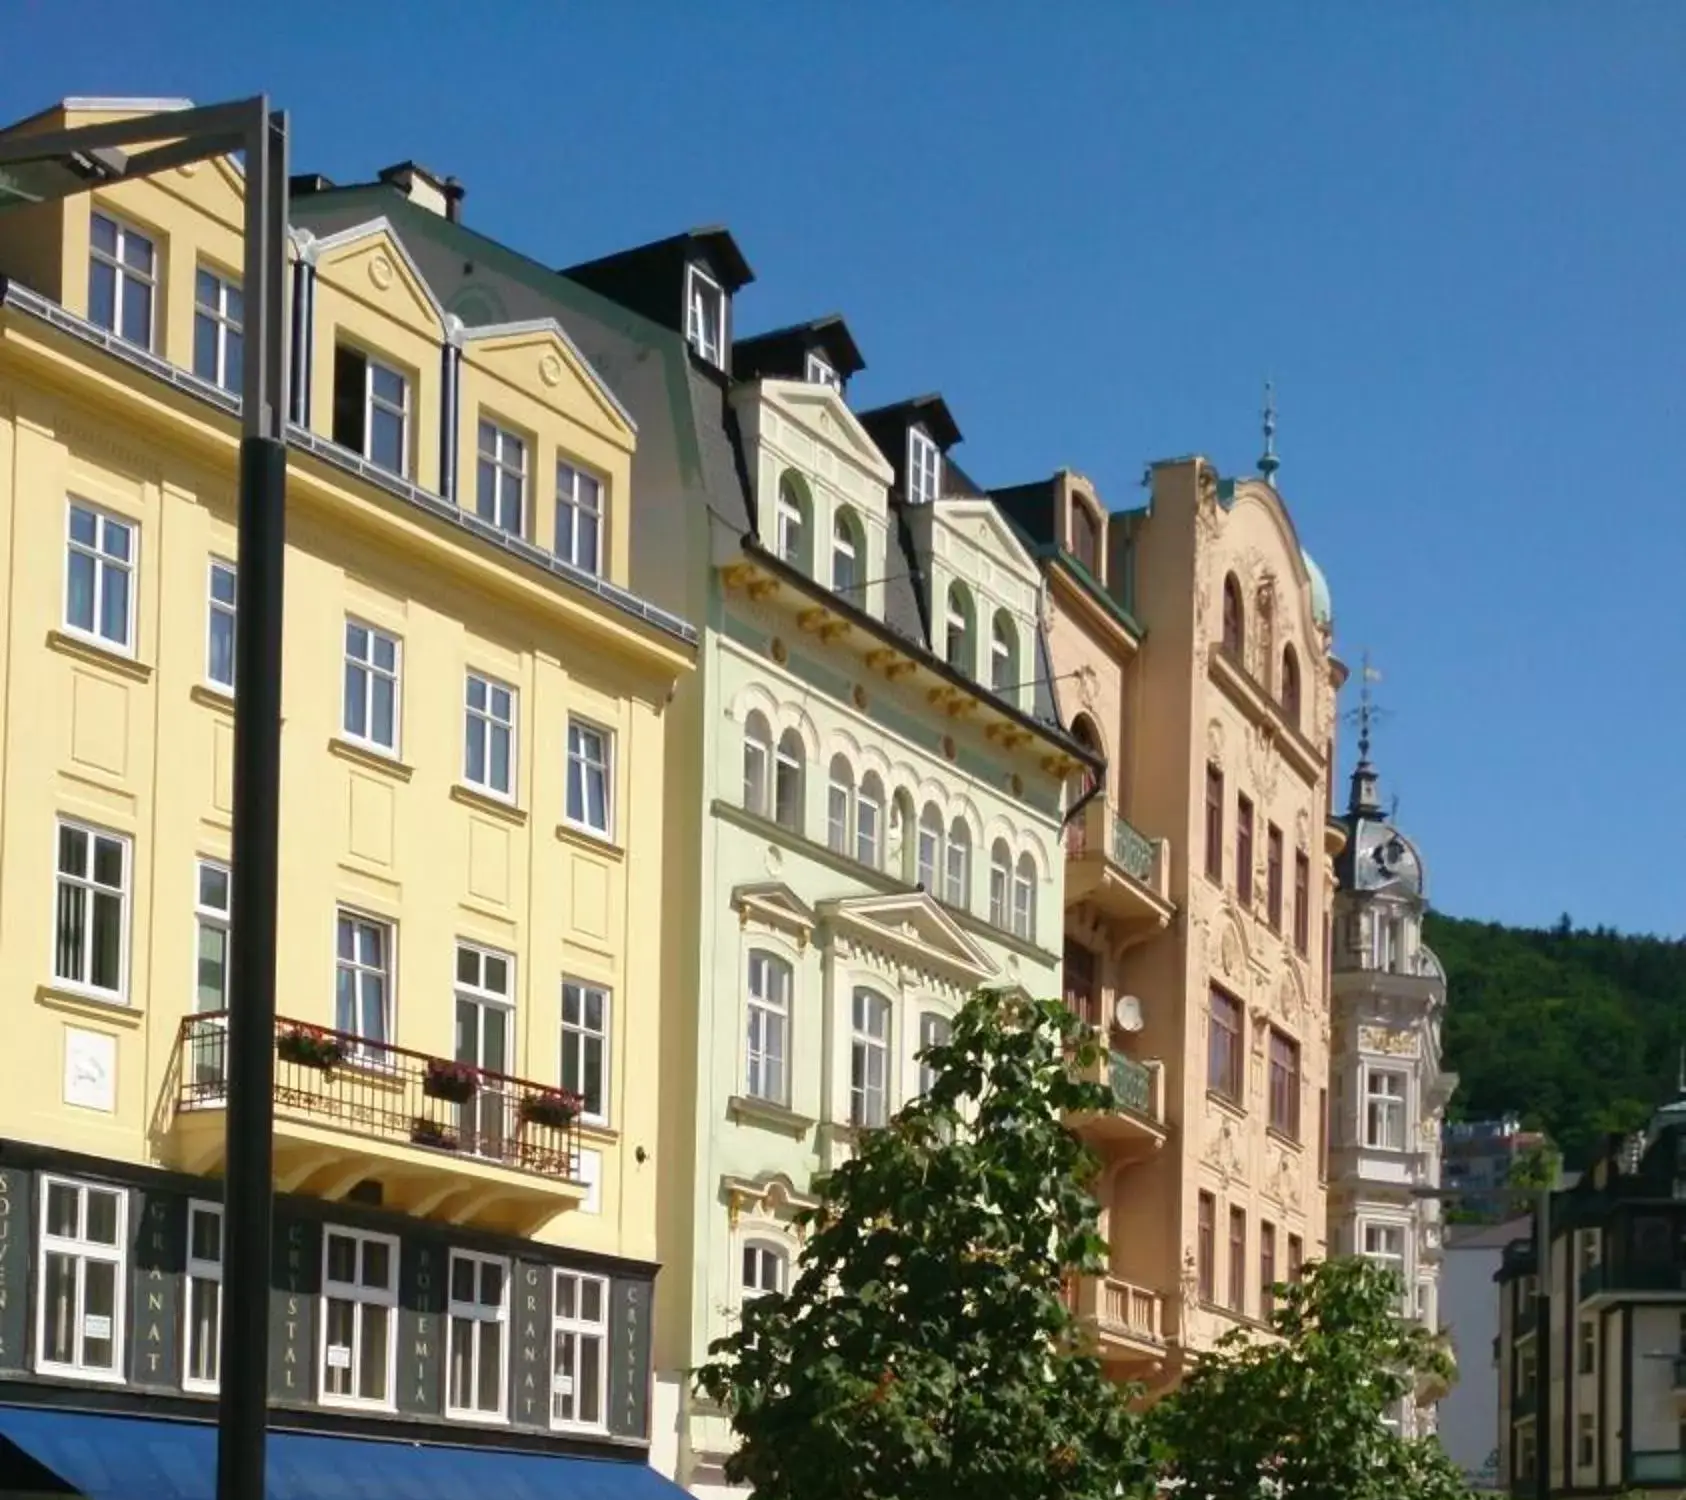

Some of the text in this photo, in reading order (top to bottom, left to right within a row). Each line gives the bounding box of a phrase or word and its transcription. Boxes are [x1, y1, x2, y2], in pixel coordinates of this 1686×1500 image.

[147, 1202, 165, 1372] GRANAT
[285, 1224, 302, 1388] CRYSTAL
[414, 1249, 431, 1402] BOHEMIA
[525, 1269, 537, 1415] GRANAT
[625, 1287, 639, 1425] CRYSTAL
